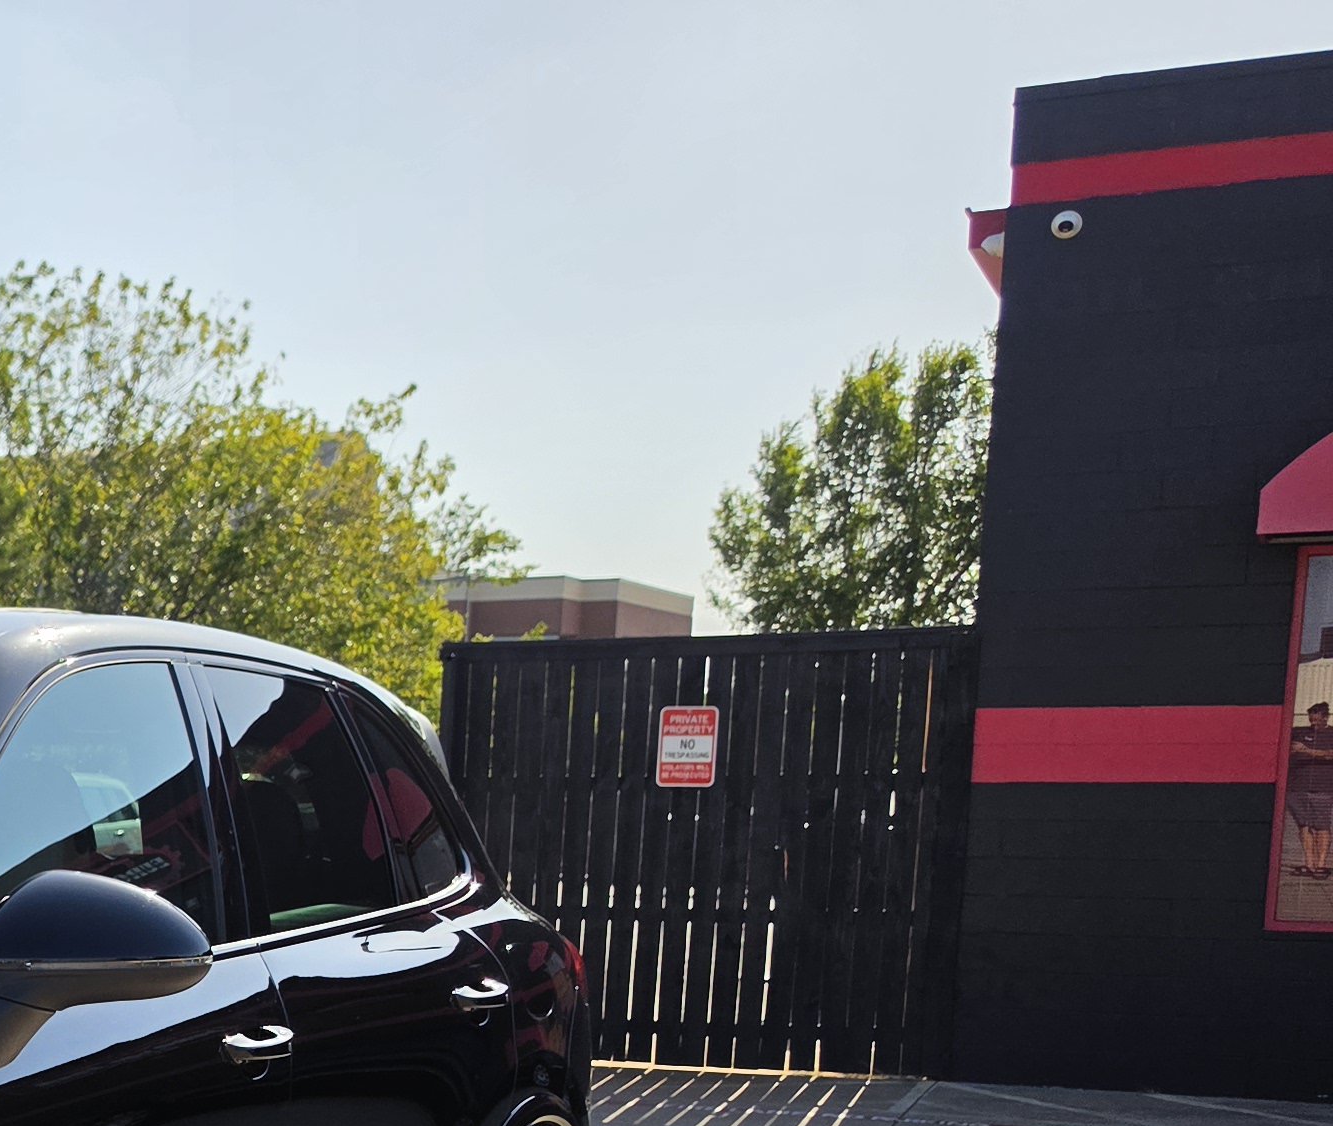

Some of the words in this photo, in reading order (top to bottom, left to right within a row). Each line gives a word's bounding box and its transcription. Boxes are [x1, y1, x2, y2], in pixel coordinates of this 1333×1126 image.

[669, 714, 709, 725] PRIVATE
[663, 725, 714, 735] PROPERTY
[680, 739, 695, 750] NO
